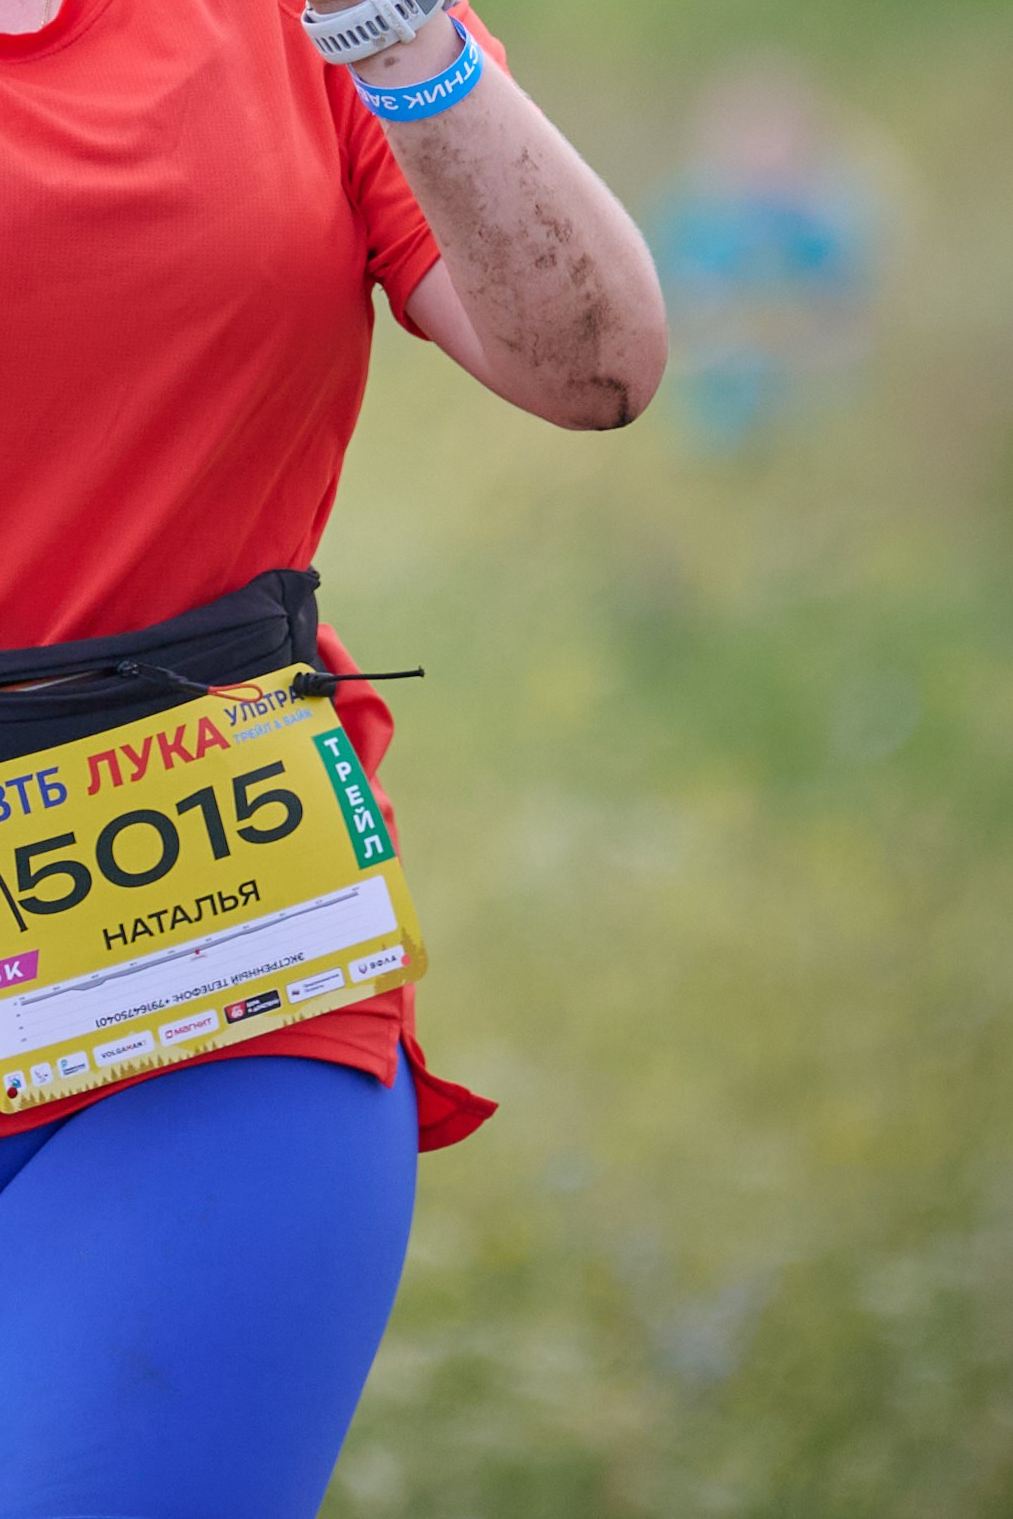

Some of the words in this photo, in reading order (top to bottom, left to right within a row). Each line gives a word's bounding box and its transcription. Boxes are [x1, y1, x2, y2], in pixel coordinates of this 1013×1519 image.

[402, 42, 481, 110] СТНИК
[224, 685, 306, 727] УЛЬТРА
[233, 721, 272, 744] ТРЕЙЛ
[87, 716, 231, 796] ЛУКА
[323, 736, 384, 859] ТРЕЙЛ
[14, 760, 303, 915] 5015
[102, 879, 261, 951] НАТАЛЬЯ
[173, 977, 228, 1003] ТЕЛЕФОН:
[230, 952, 305, 985] ЭКСТРЕННЫЙ
